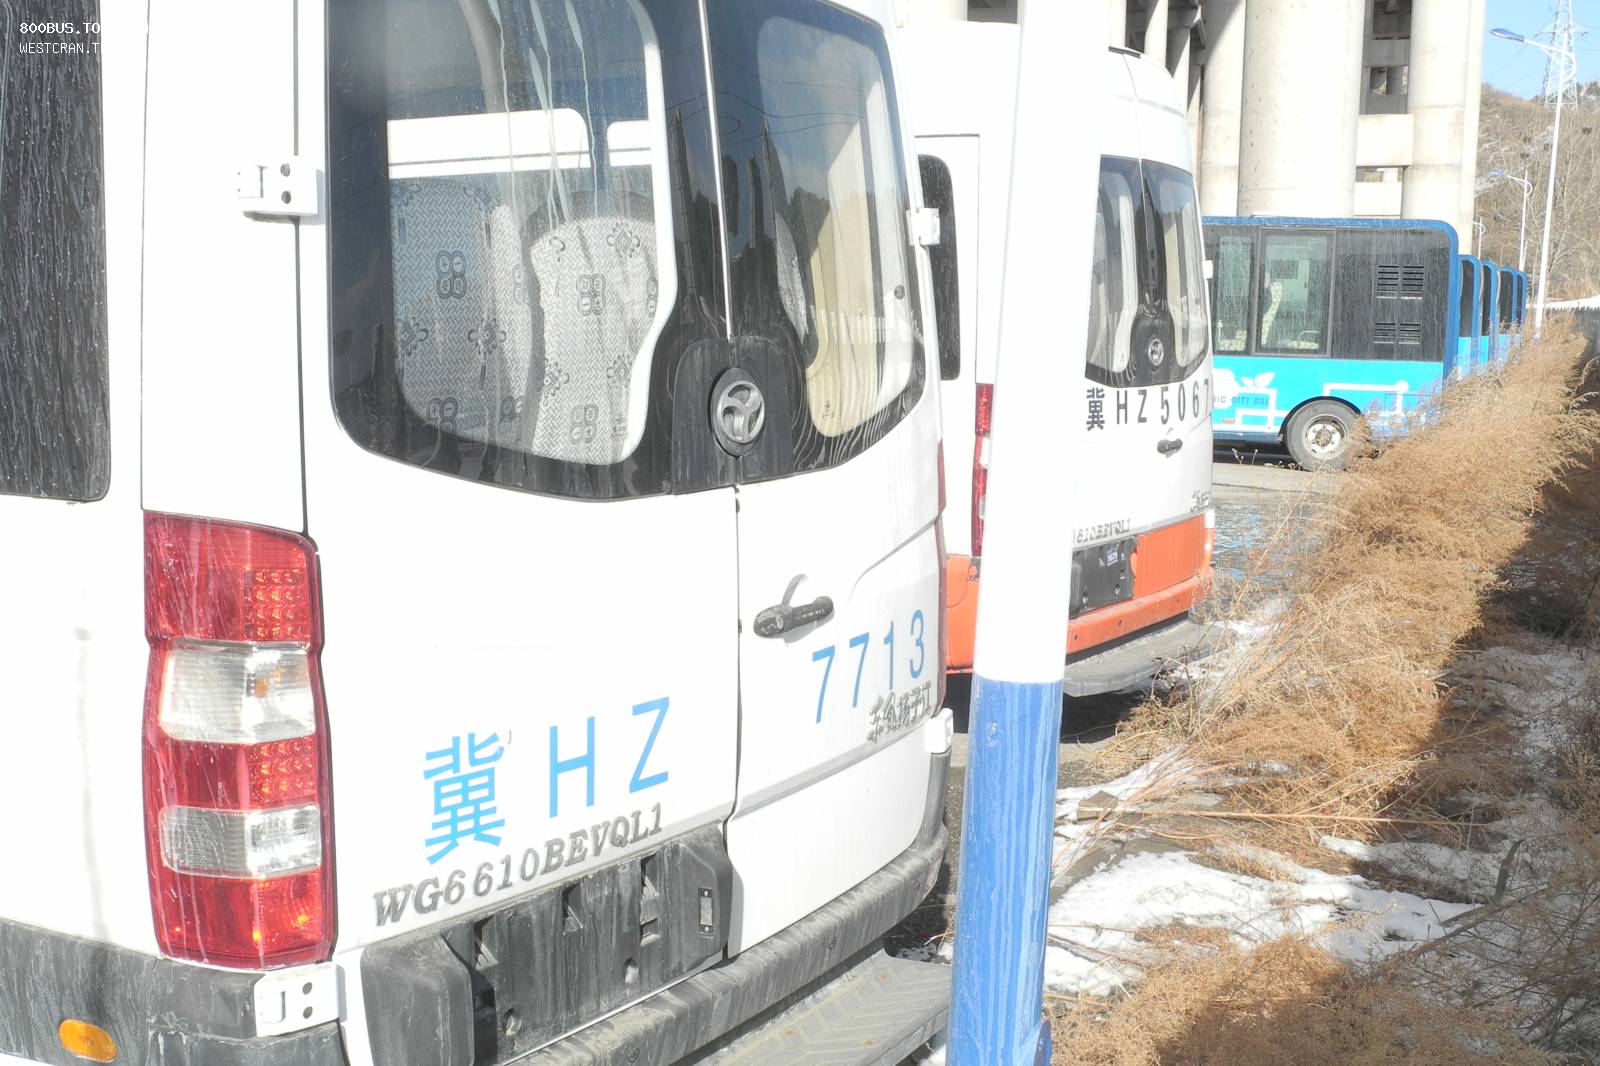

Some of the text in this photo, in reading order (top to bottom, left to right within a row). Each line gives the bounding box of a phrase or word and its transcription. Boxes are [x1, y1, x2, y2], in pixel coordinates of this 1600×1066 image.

[1231, 396, 1250, 404] CITY
[1254, 397, 1269, 405] BUS
[373, 802, 663, 927] WG6610BEVQL1
